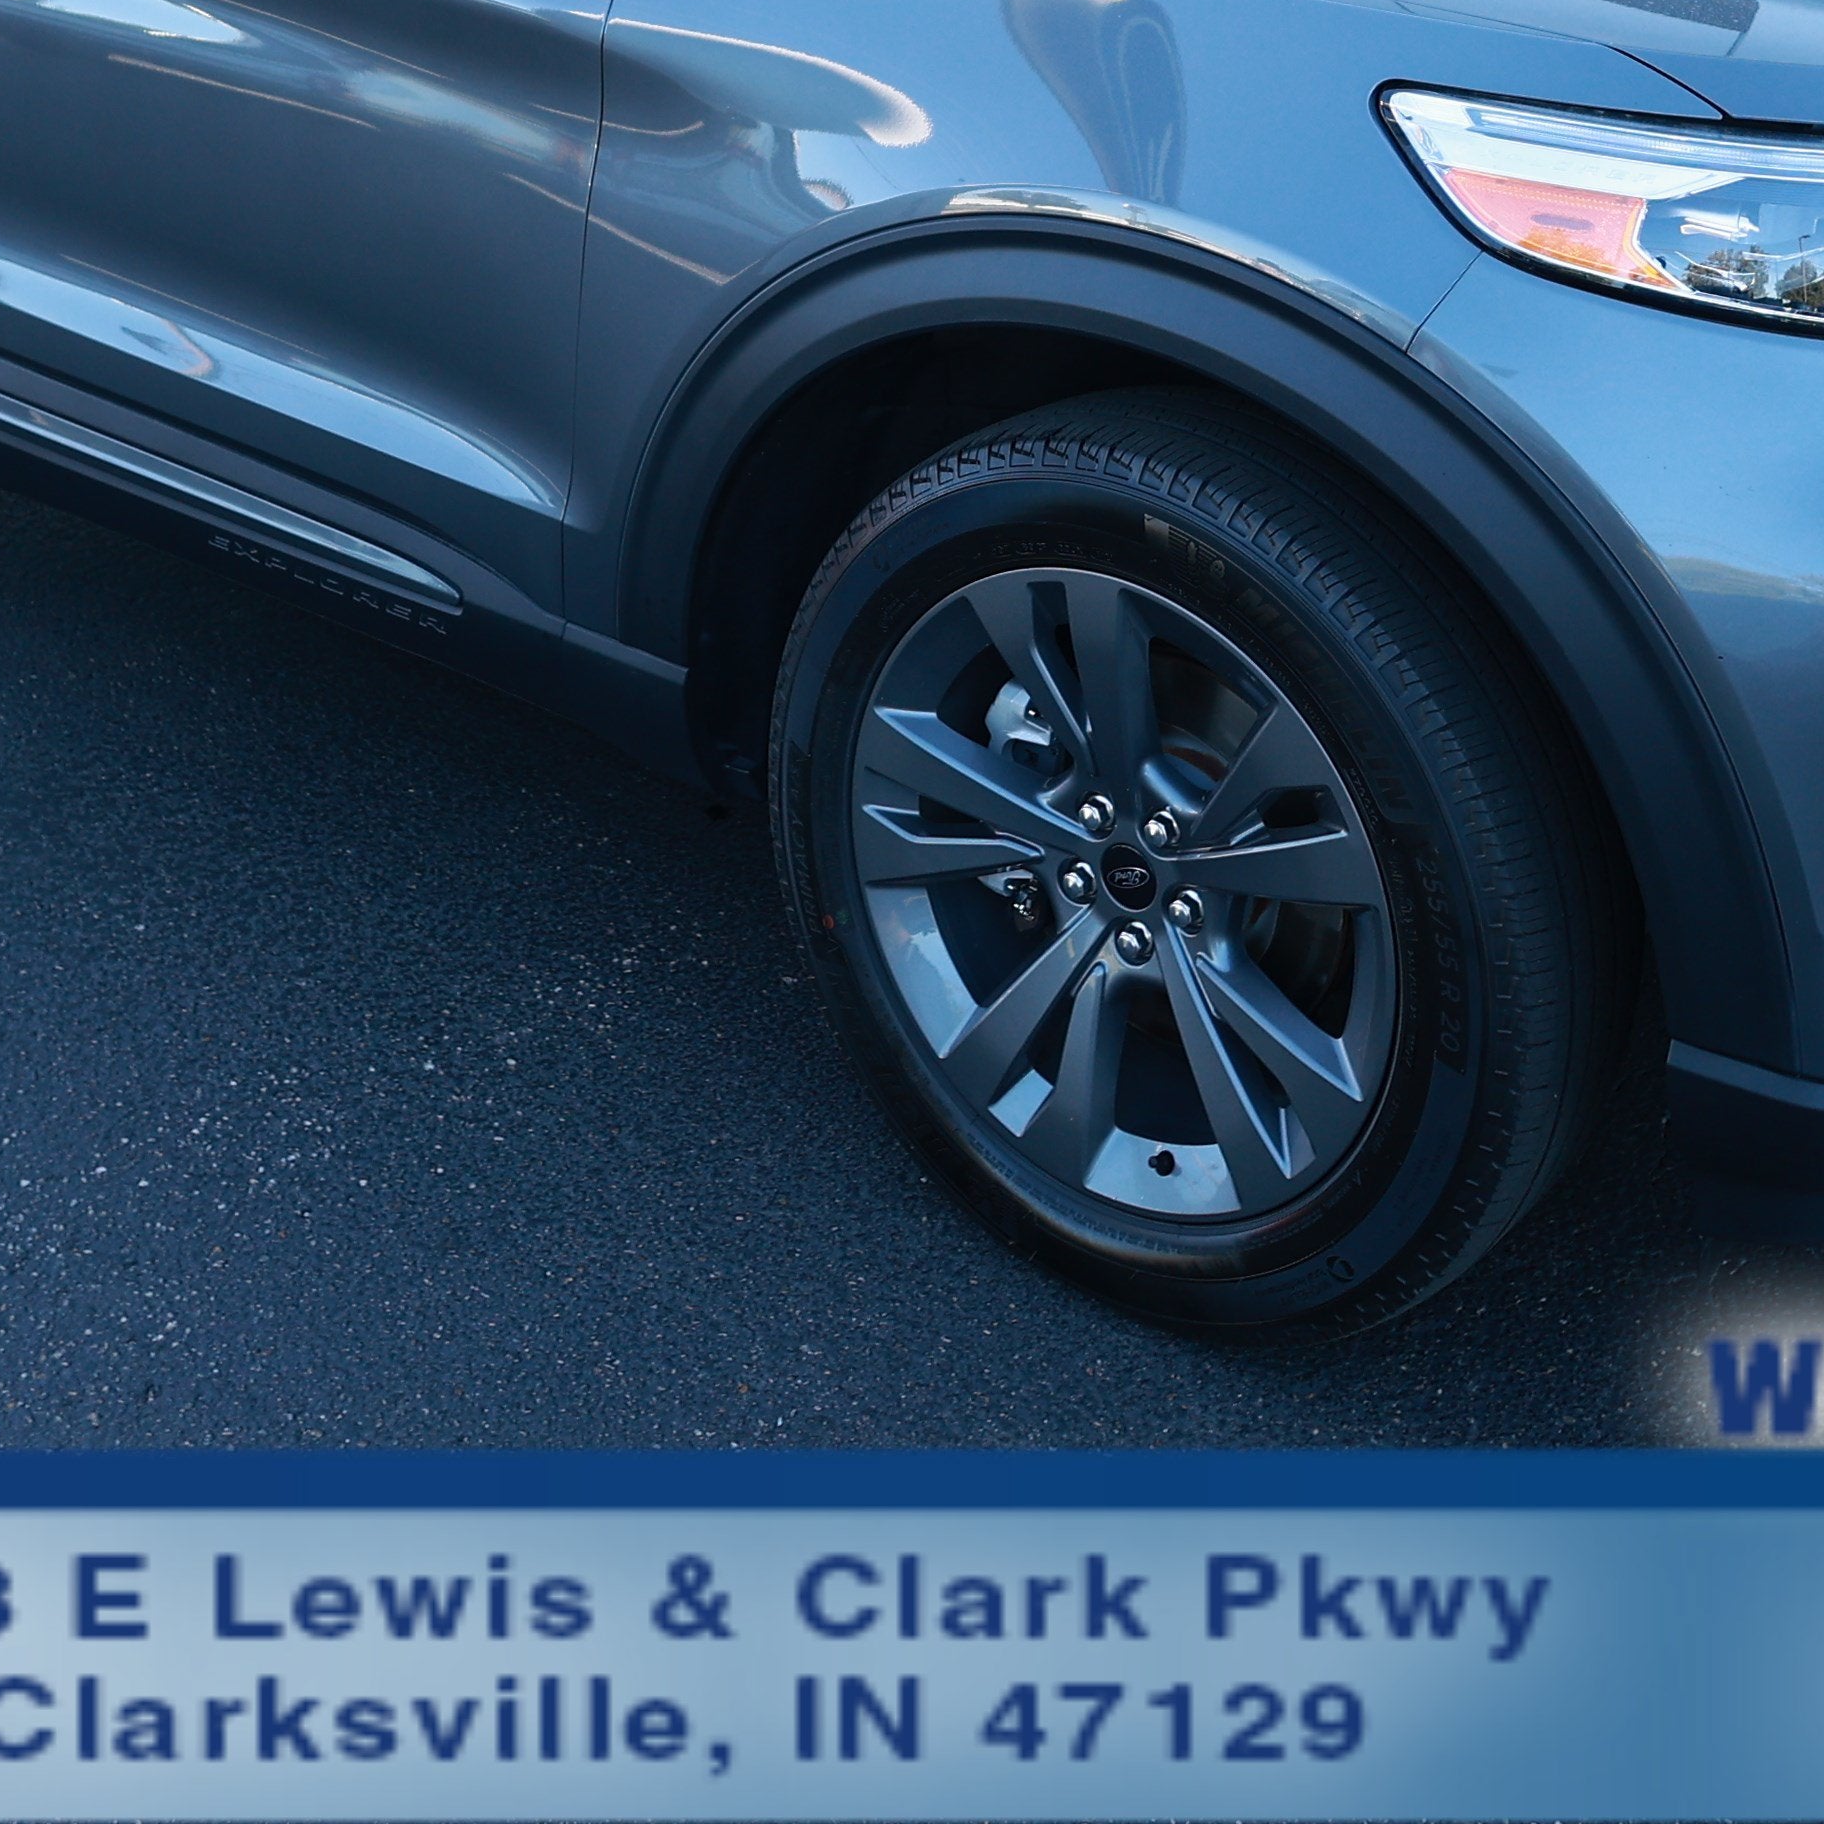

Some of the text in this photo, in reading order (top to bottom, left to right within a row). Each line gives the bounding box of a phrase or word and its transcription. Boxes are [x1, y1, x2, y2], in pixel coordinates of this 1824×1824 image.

[207, 534, 449, 637] EXPLORER
[1437, 979, 1462, 1004] R
[1439, 1011, 1463, 1054] 20
